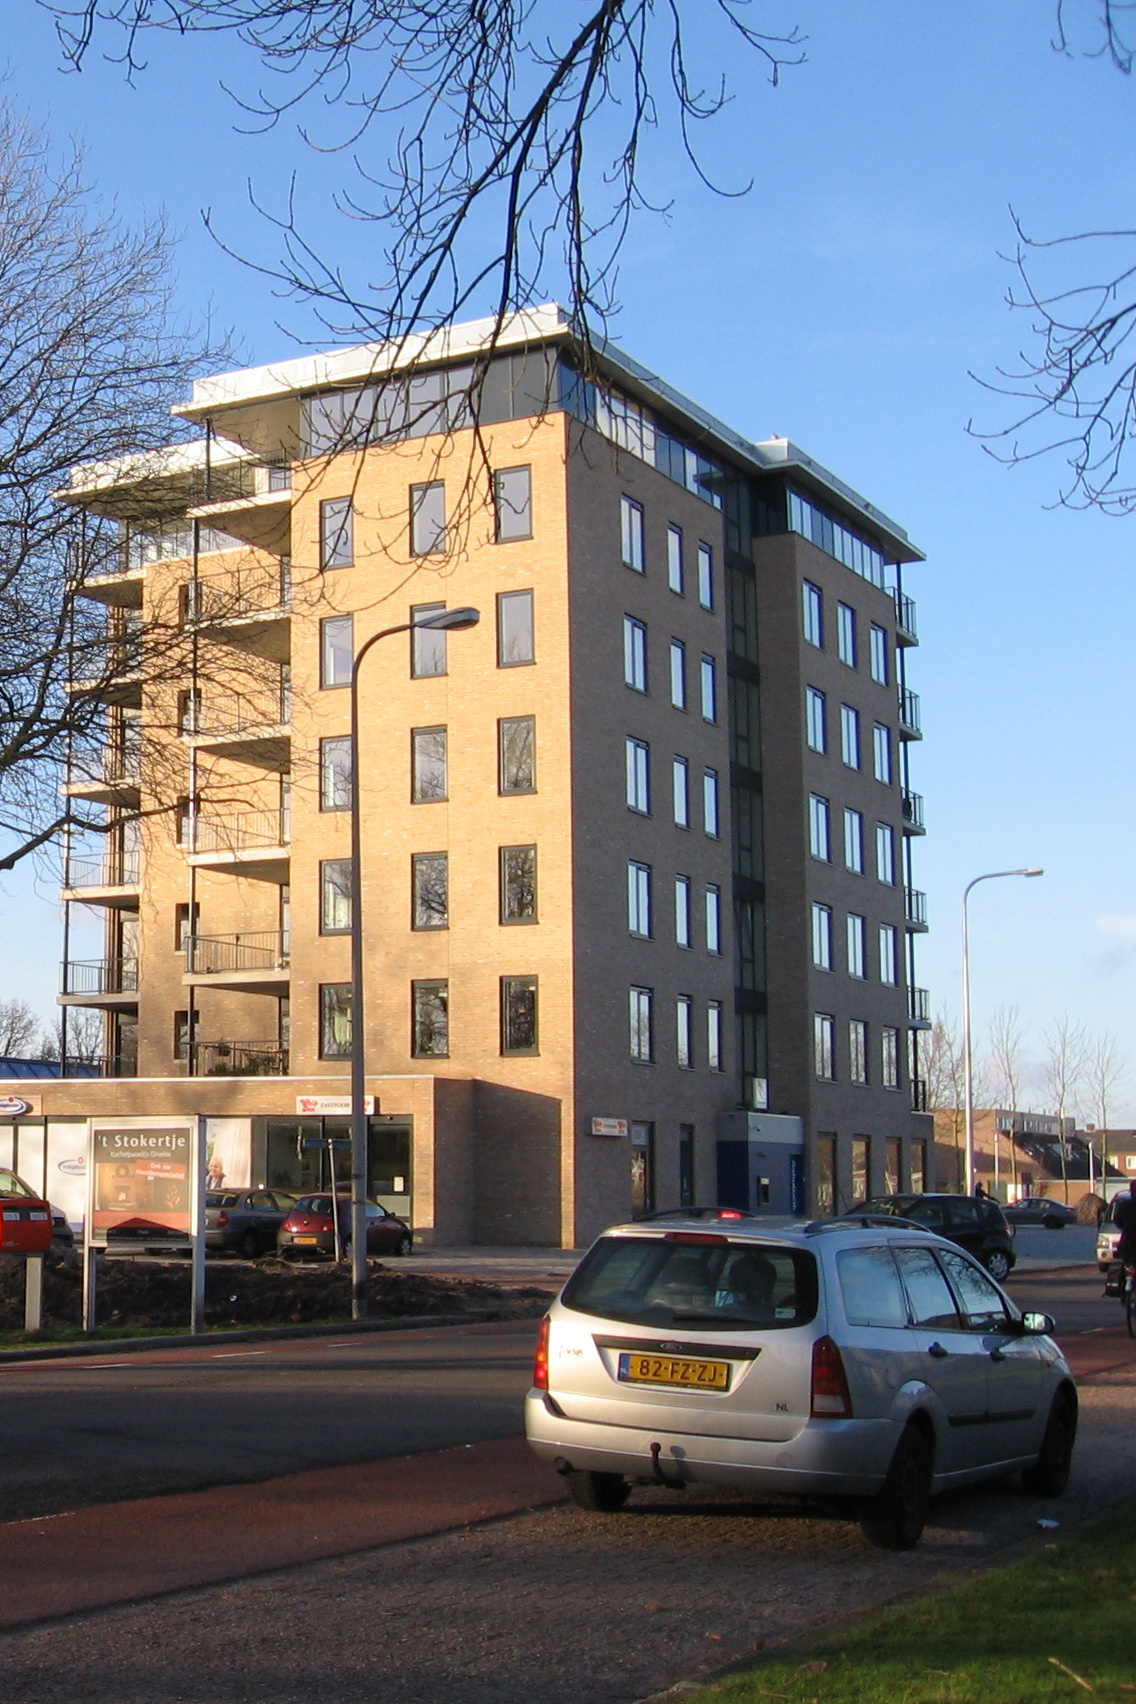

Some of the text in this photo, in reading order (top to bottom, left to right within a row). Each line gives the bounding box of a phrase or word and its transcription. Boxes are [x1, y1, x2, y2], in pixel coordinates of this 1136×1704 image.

[98, 1134, 186, 1151] 't Stokertje
[639, 1359, 717, 1382] 82-FZ-ZJ
[776, 1403, 789, 1411] NL
